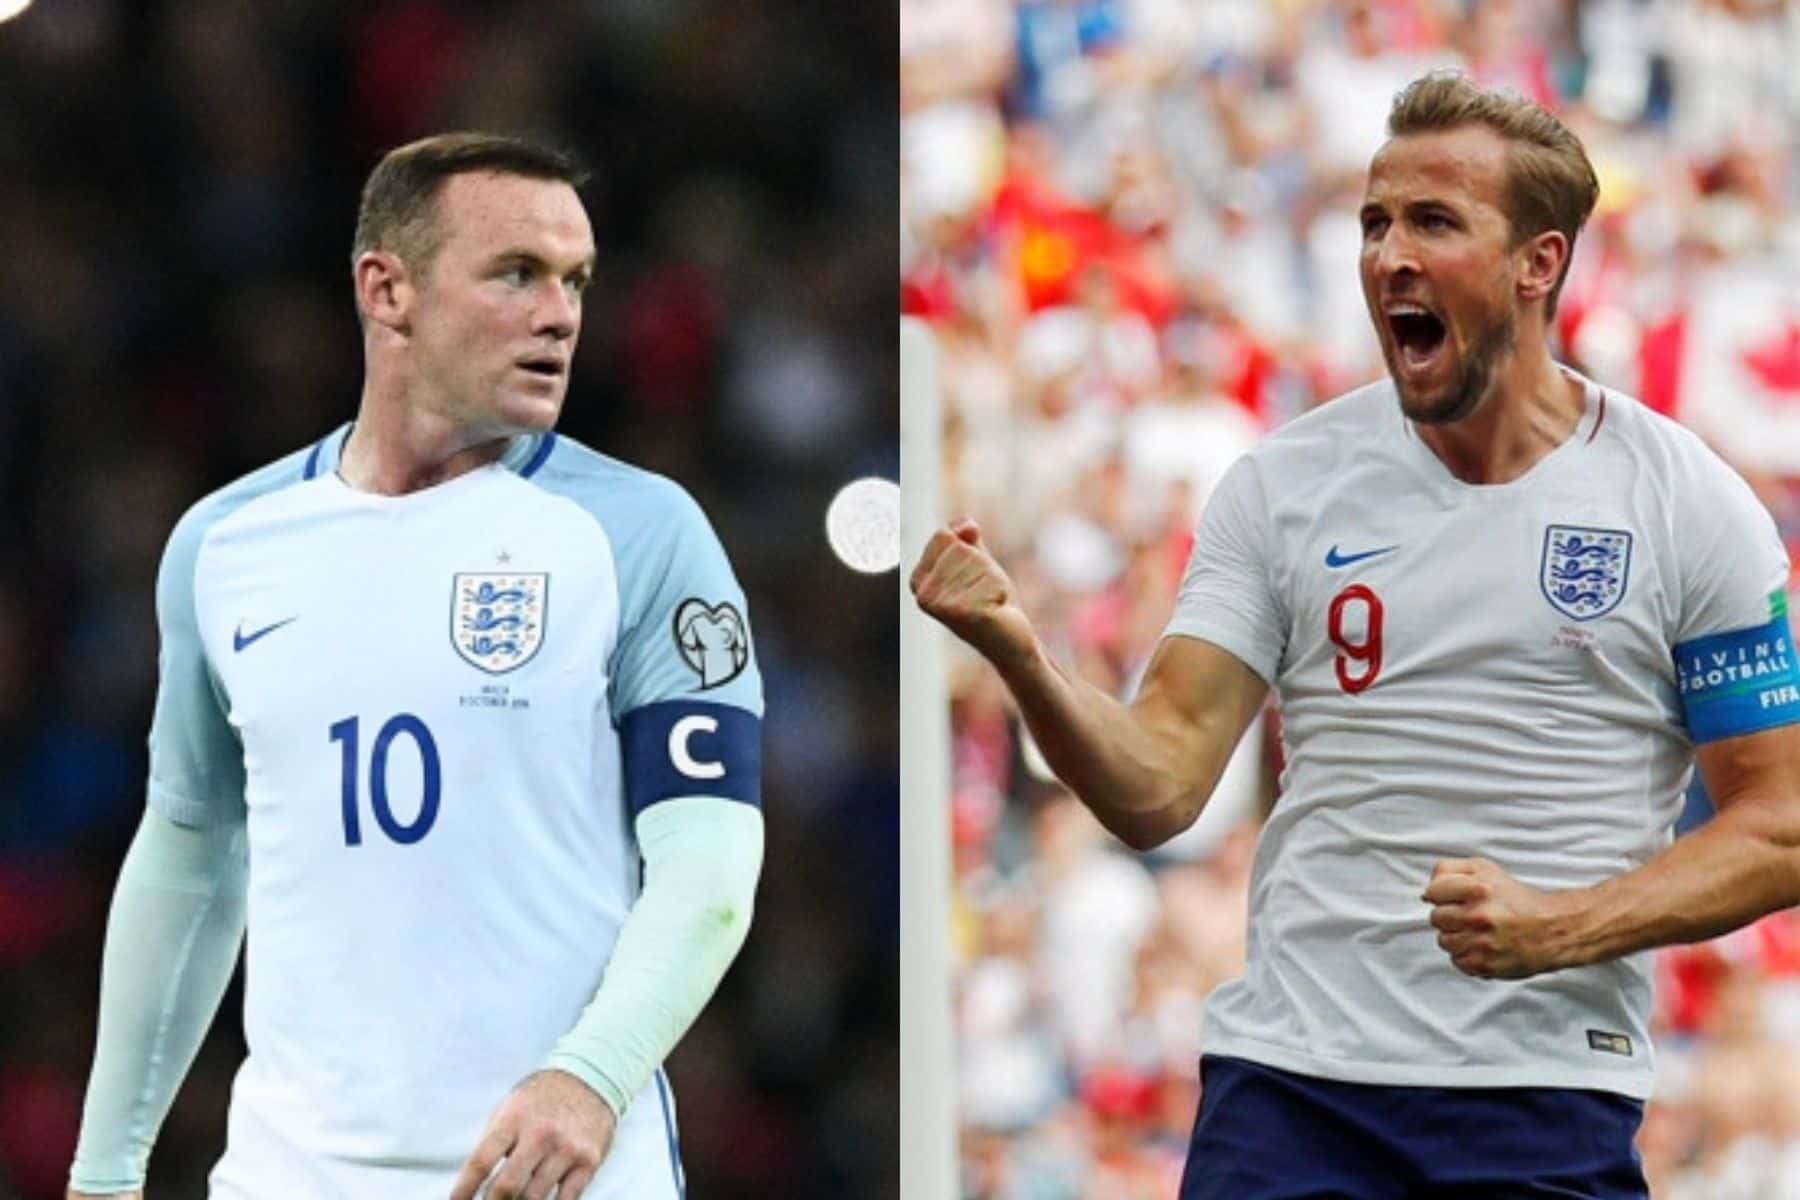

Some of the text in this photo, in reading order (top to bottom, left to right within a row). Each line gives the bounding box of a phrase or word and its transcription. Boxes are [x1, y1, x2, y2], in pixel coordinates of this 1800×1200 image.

[1328, 583, 1383, 695] 9
[1760, 685, 1800, 709] FIFA
[328, 712, 442, 846] 10
[668, 715, 726, 779] C
